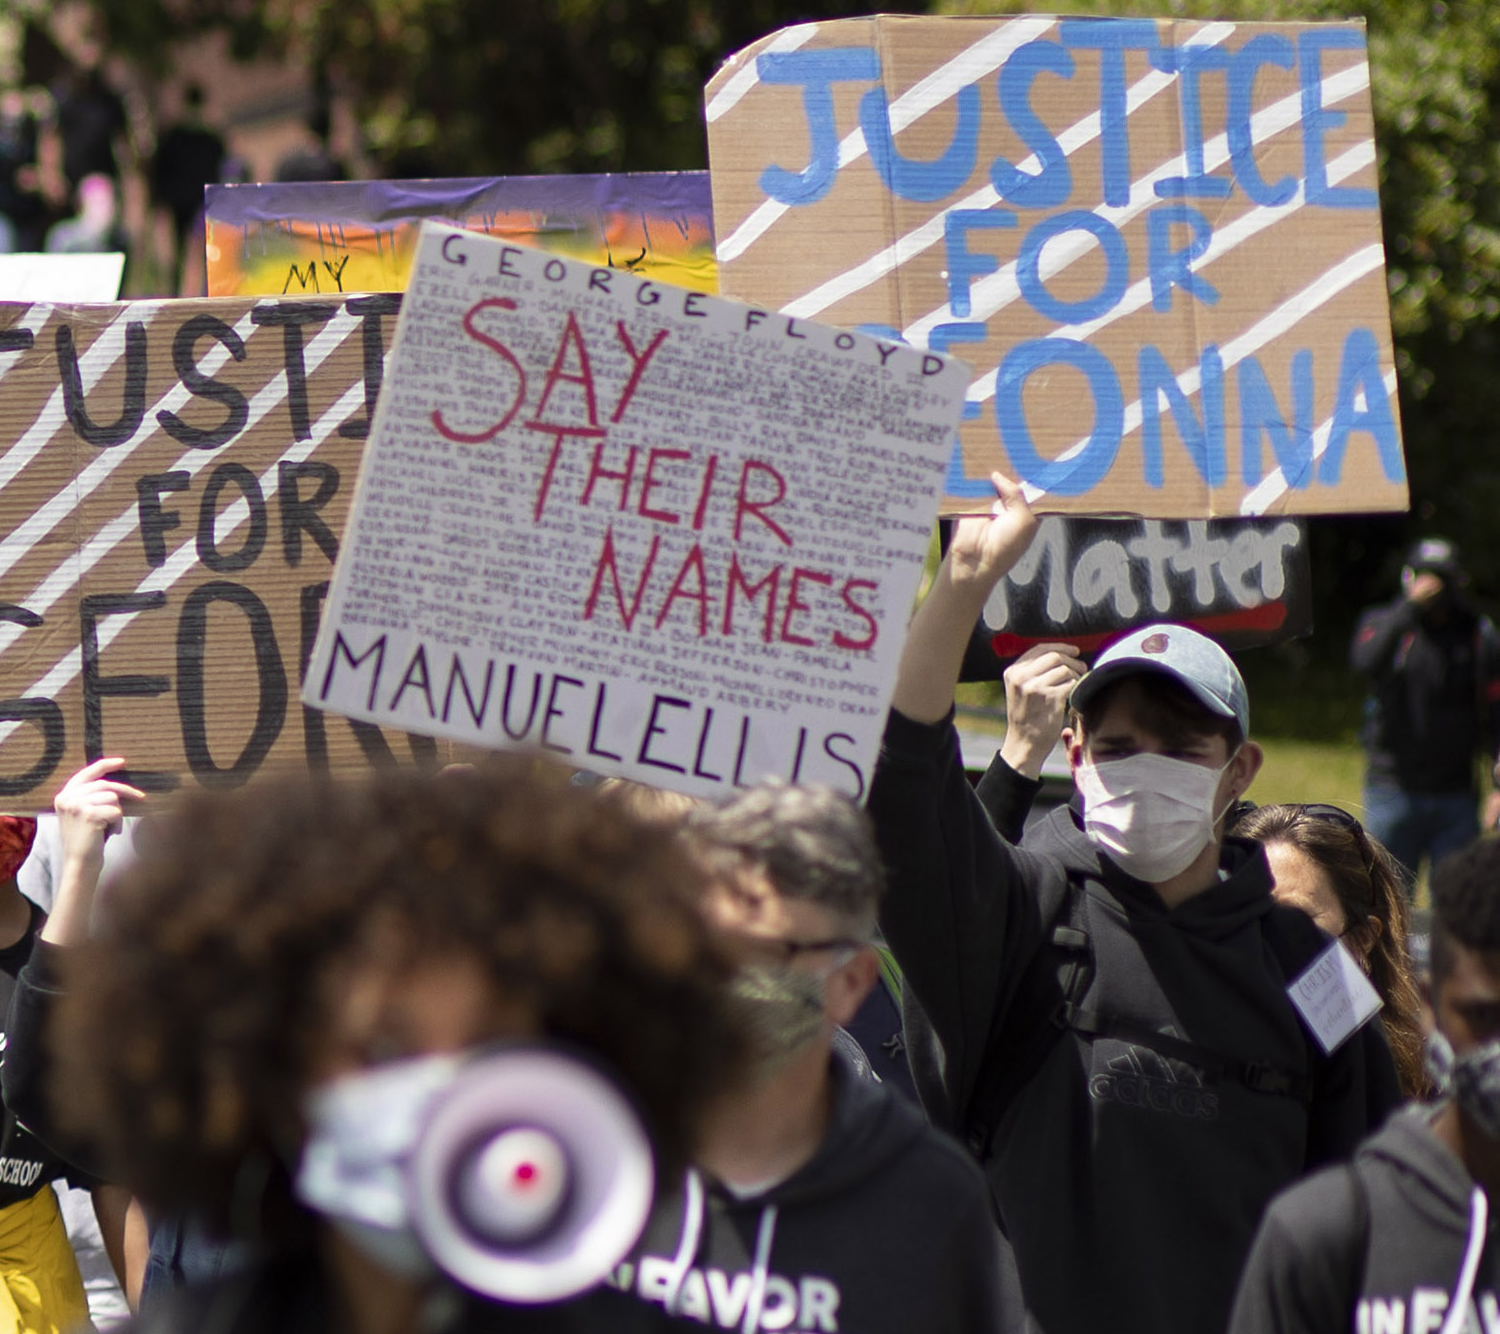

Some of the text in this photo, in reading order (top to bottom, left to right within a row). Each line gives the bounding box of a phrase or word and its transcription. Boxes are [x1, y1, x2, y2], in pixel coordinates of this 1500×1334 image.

[756, 19, 1379, 209] JUSTICE
[441, 234, 945, 378] GEORGE FLOYD
[943, 208, 1221, 324] FOR
[430, 296, 670, 444] SAY
[135, 460, 340, 573] FOR
[523, 421, 794, 547] THEIR
[583, 529, 881, 651] NAMES
[982, 517, 1301, 631] Matter
[1088, 1073, 1220, 1120] adidas
